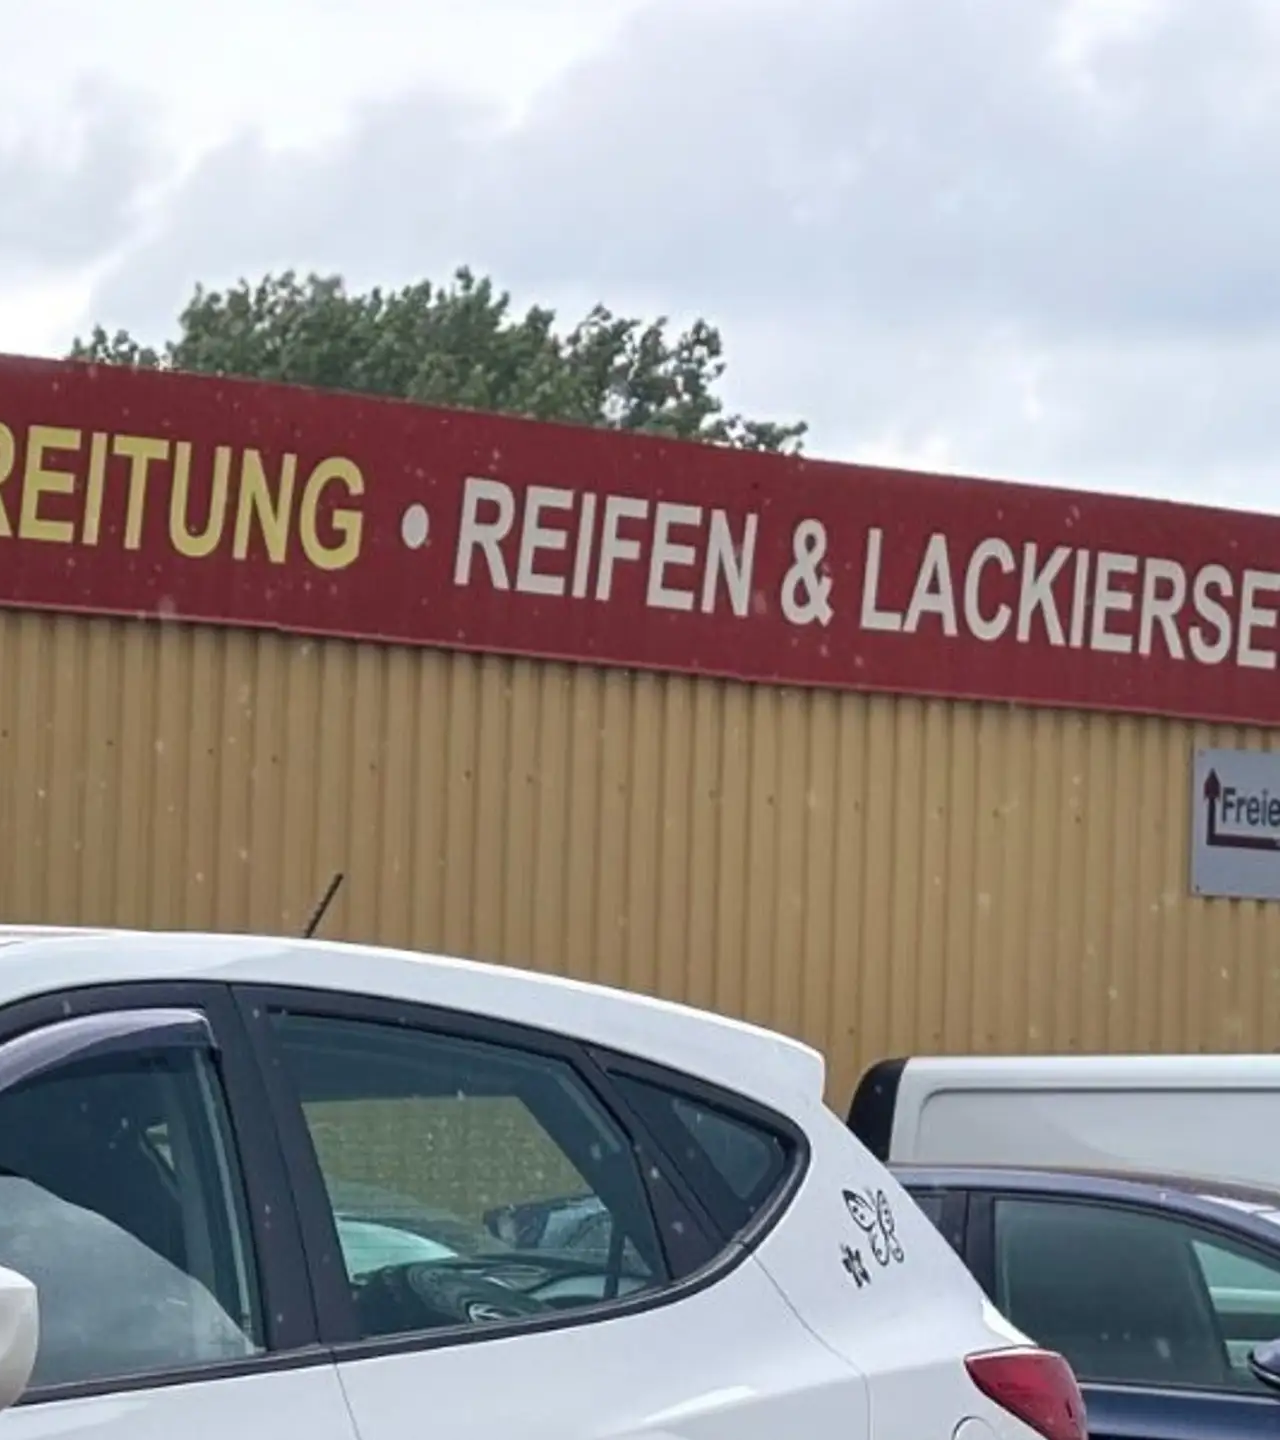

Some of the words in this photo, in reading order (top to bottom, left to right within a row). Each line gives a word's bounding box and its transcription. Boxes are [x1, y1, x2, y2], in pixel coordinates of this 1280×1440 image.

[453, 477, 757, 617] REIFEN
[781, 518, 832, 626] &
[860, 527, 1280, 670] LACKIERSE
[1222, 786, 1280, 827] Freie
